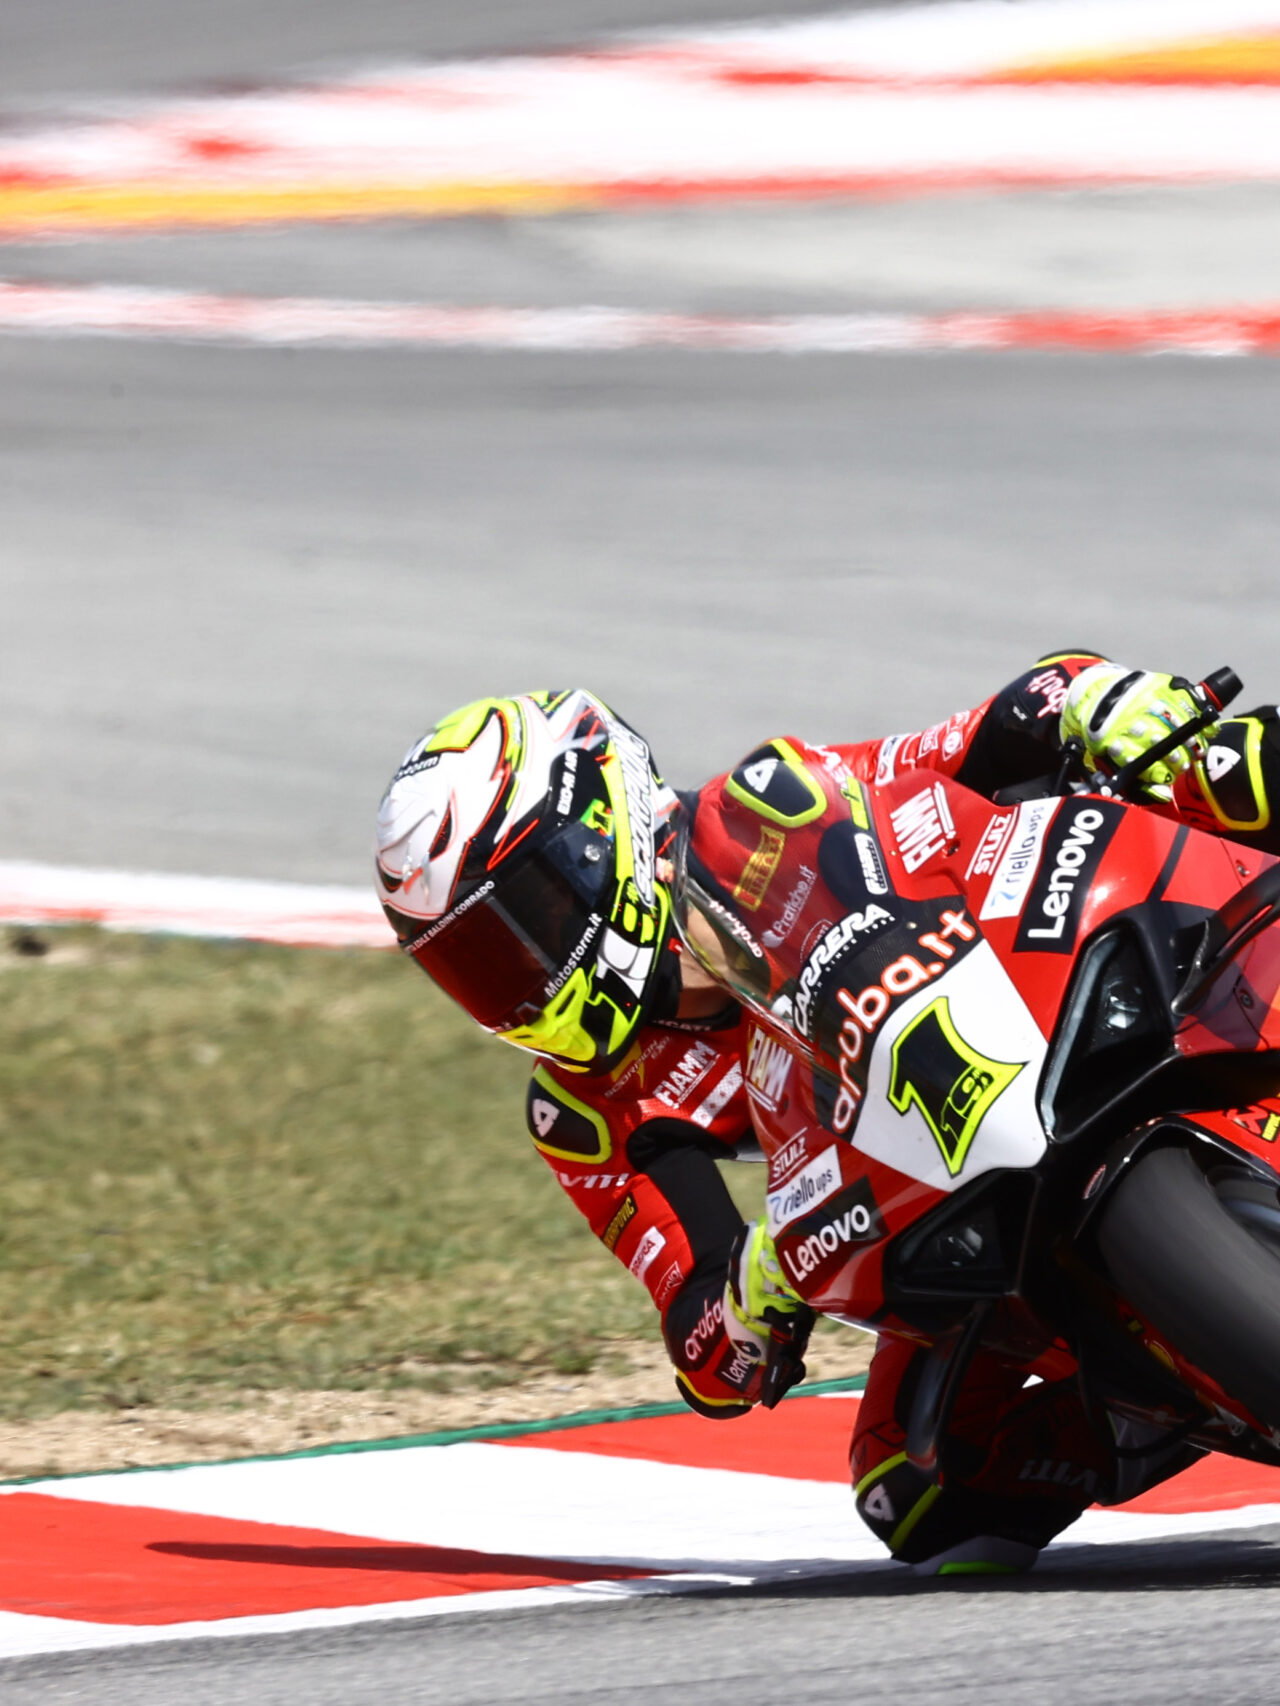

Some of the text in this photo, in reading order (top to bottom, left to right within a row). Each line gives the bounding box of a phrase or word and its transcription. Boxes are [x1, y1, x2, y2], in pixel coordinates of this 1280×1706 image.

[890, 787, 946, 875] FIAMM
[973, 814, 1012, 876] STULZ
[1006, 834, 1036, 885] riello
[452, 878, 496, 917] CORRADO
[1027, 808, 1105, 939] Lenovo
[544, 912, 603, 998] Motostorm.it
[794, 903, 891, 1036] CARRERA
[825, 937, 857, 973] SINCE
[832, 907, 978, 1134] aruba.it
[655, 1041, 717, 1106] FIAMM
[746, 1027, 793, 1102] FIAMM
[773, 1137, 806, 1178] STULZ
[782, 1168, 833, 1216] riello ups
[783, 1204, 871, 1283] Lenovo
